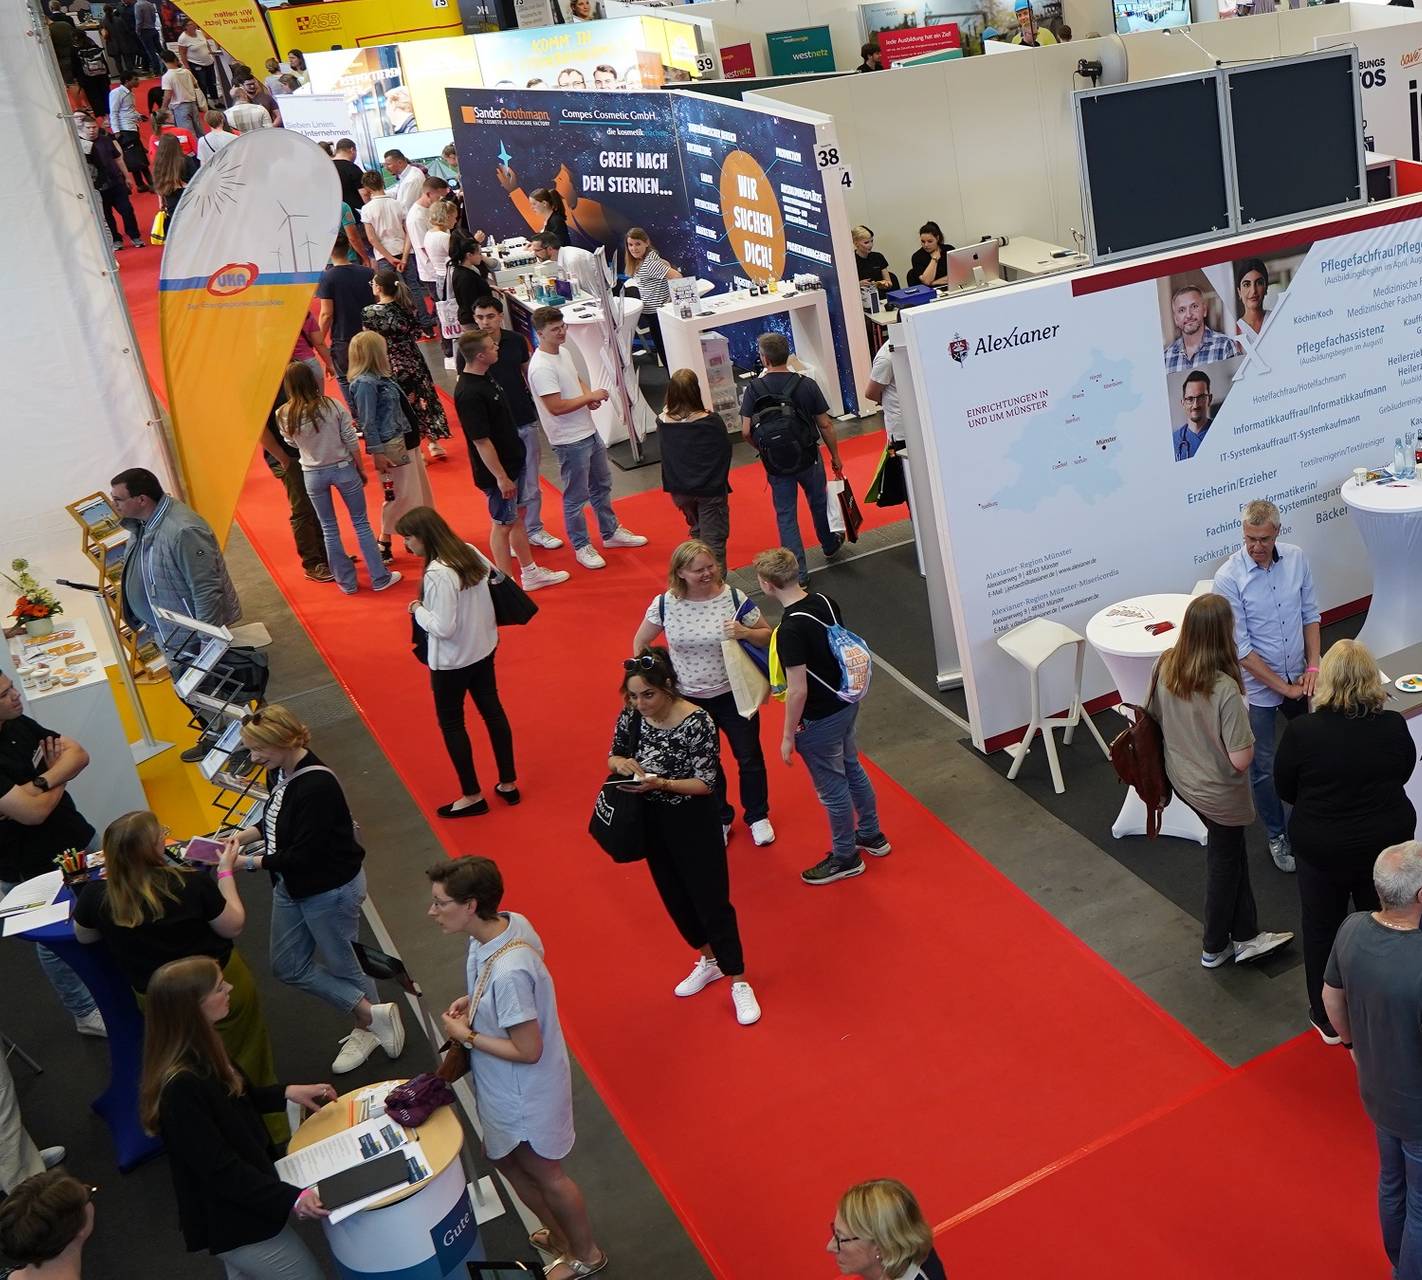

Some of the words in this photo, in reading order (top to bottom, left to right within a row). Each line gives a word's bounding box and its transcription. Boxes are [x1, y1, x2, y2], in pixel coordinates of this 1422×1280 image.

[309, 13, 340, 30] ASB
[697, 57, 713, 71] 39
[792, 49, 828, 61] westnetz
[1360, 69, 1387, 89] OS
[562, 109, 593, 121] Compes
[594, 110, 630, 121] Cosmetic
[607, 128, 616, 136] die
[600, 151, 633, 169] GREIF
[637, 152, 668, 170] NACH
[818, 148, 840, 168] 38
[582, 175, 604, 192] DEN
[608, 176, 673, 196] STERNEN...
[737, 174, 759, 200] WIR
[841, 172, 852, 187] 4
[733, 206, 773, 238] SUCHEN
[744, 240, 773, 271] DICH!
[1373, 278, 1418, 297] Medizinische
[1347, 298, 1396, 318] Medizinischer
[974, 325, 1060, 356] Alexianer
[1296, 324, 1385, 355] Pflegefachassistenz
[1252, 372, 1347, 405] Hotelfachfrau/Hotelfachmann
[966, 392, 1038, 418] EINRICHTUNGEN
[1039, 389, 1049, 399] IN
[1233, 384, 1387, 435] Informatikkauffrau/Informatikkaufmann
[968, 416, 988, 428] UND
[989, 411, 1005, 423] UM
[1006, 400, 1049, 419] MÜNSTER
[1095, 434, 1117, 446] Münster
[1219, 414, 1361, 463] IT-Systemkauffrau/IT-Systemkaufmann
[1187, 468, 1278, 505] Erzieherin/Erzieher
[1044, 548, 1073, 562] Münster
[1194, 545, 1230, 565] Fachkraft
[443, 1212, 470, 1247] Gute
